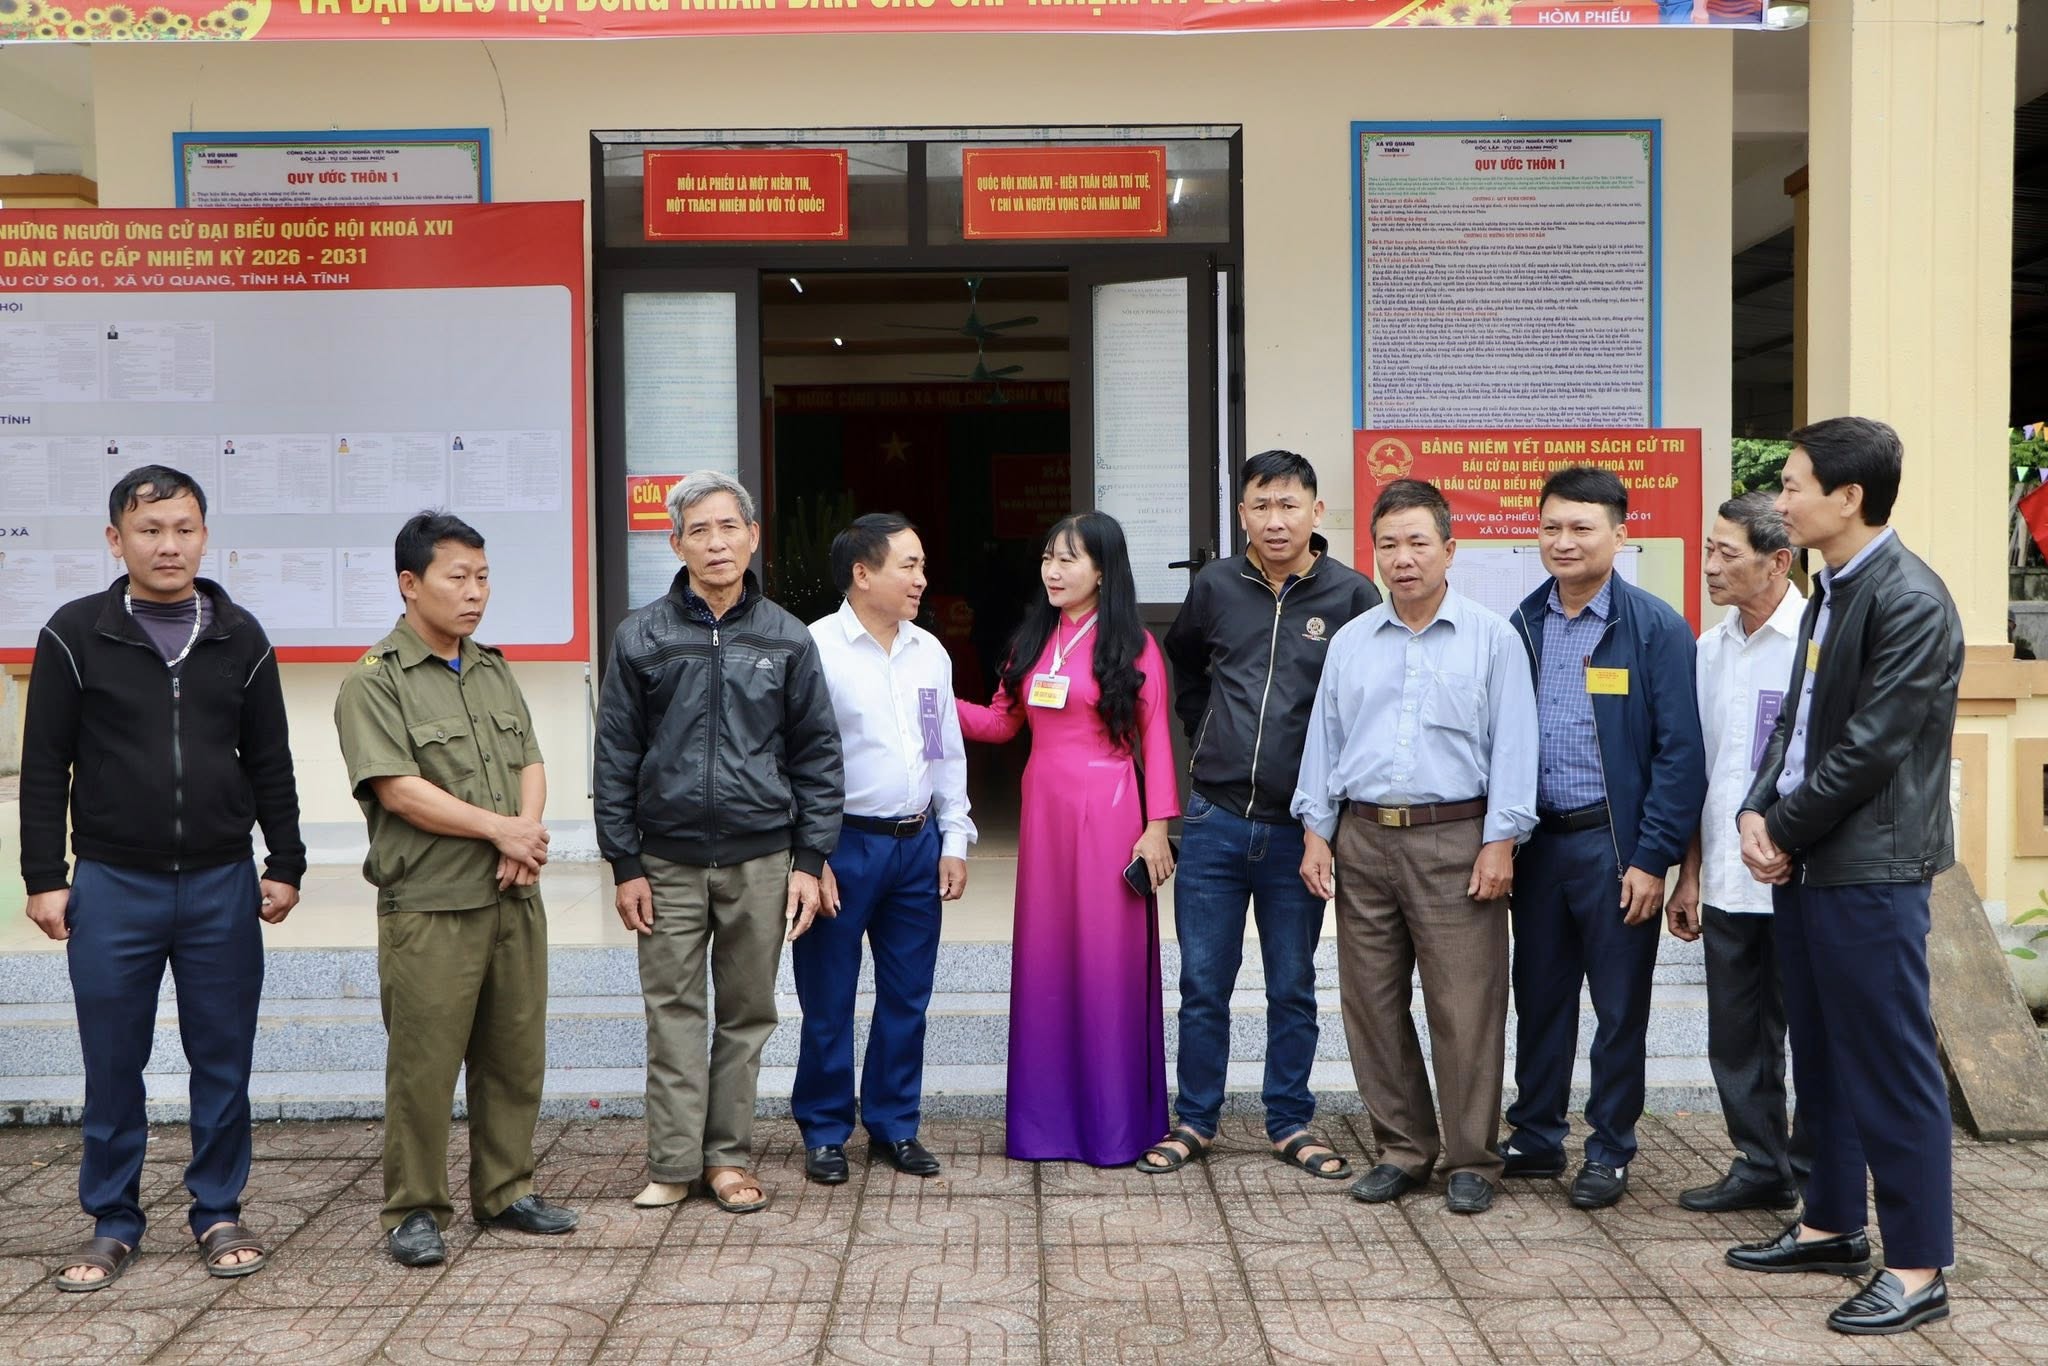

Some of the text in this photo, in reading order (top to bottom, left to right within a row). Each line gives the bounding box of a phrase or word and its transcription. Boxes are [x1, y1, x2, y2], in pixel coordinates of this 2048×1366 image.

[1538, 7, 1630, 24] HÒM PHIẾU
[1475, 156, 1565, 172] QUY ƯỚC THÔN 1
[287, 169, 398, 185] QUY ƯỚC THÔN 1
[697, 175, 707, 191] LÁ
[709, 173, 735, 191] PHIẾU
[737, 175, 747, 191] LÀ
[749, 175, 768, 192] MỘT
[794, 177, 811, 192] TIN,
[977, 173, 999, 192] QUỐC
[1001, 174, 1014, 192] HỘI
[1016, 175, 1038, 190] KHÓA
[1040, 176, 1053, 189] XVI
[1060, 174, 1078, 191] HIỆN
[1080, 173, 1100, 189] THÂN
[1102, 172, 1118, 189] CỦA
[1120, 172, 1133, 189] TRÍ
[1134, 174, 1151, 191] TUỆ,
[666, 197, 685, 214] MỘT
[688, 197, 717, 213] TRÁCH
[719, 196, 746, 215] NHIỆM
[749, 194, 764, 212] ĐỐI
[767, 196, 782, 212] VỚI
[798, 194, 825, 213] QUỐC!
[990, 194, 1141, 214] Ý CHÍ VÀ NGUYỆN VỌNG CỦA NHÂN DÂN!
[63, 220, 120, 240] NGƯỜI
[125, 220, 163, 240] ỨNG
[168, 219, 195, 239] CỬ
[198, 223, 228, 242] ĐẠI
[234, 217, 275, 238] BIỂU
[281, 217, 329, 239] QUỐC
[335, 218, 364, 240] HỘI
[370, 217, 419, 237] KHOÁ
[424, 220, 453, 236] XVI
[4, 247, 47, 267] DÂN
[53, 247, 94, 267] CÁC
[100, 245, 141, 267] CẤP
[147, 247, 214, 270] NHIỆM
[220, 246, 246, 266] KỲ
[252, 249, 301, 266] 2026
[321, 248, 367, 264] 2031
[81, 276, 105, 288] 01,
[114, 273, 138, 286] XÃ
[141, 273, 165, 286] VŨ
[169, 275, 235, 287] QUANG,
[240, 272, 278, 285] TỈNH
[284, 272, 307, 285] HÀ
[312, 271, 350, 284] TĨNH
[0, 302, 23, 314] HỘI
[1421, 435, 1685, 454] BẢNG NIÊM YẾT DANH SÁCH CỬ TRI
[1463, 457, 1483, 472] BẦU
[1486, 457, 1500, 472] CỬ
[1502, 460, 1520, 474] ĐẠI
[1522, 456, 1545, 472] BIỂU
[1598, 458, 1624, 471] KHOÁ
[1628, 460, 1644, 471] XVI
[633, 479, 662, 504] CỬA
[1444, 475, 1465, 490] BẦU
[1467, 474, 1482, 490] CỬ
[1483, 478, 1501, 493] ĐẠI
[1504, 474, 1527, 490] BIỂU
[1529, 476, 1545, 492] HỘ
[1635, 475, 1656, 489] CÁC
[1658, 474, 1679, 488] CẤP
[1500, 494, 1533, 510] NHIỆM
[1450, 513, 1464, 521] HU
[1466, 513, 1487, 524] VỰC
[1488, 510, 1503, 521] BỎ
[1505, 511, 1535, 521] PHIẾU
[1640, 512, 1651, 521] 01
[11, 526, 29, 537] XÃ
[1479, 525, 1540, 535] XÃ VŨ QUAN
